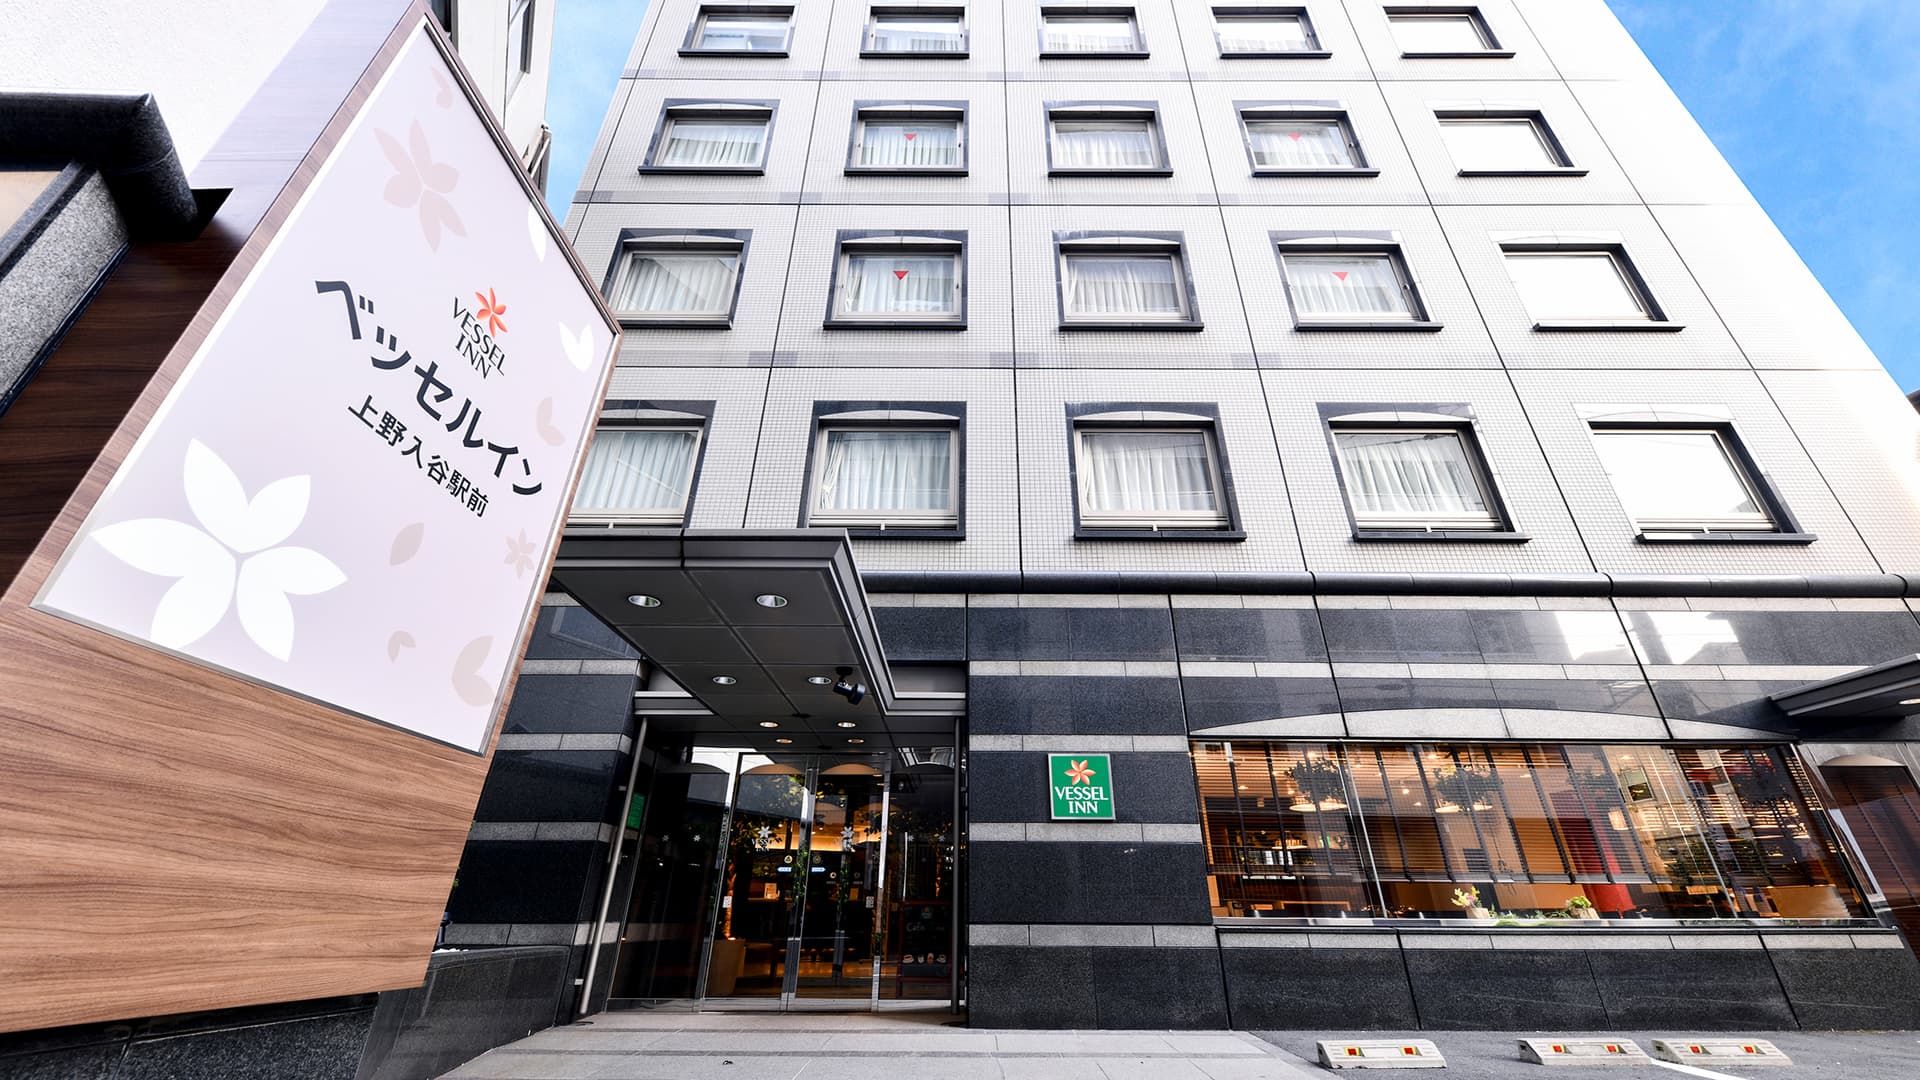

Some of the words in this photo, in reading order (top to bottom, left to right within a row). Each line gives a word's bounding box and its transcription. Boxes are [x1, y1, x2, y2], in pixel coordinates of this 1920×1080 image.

[453, 296, 505, 377] VESSEL
[455, 333, 492, 380] INN
[315, 280, 543, 496] ベッセルイン
[347, 394, 489, 518] 上野入谷駅前
[1054, 786, 1109, 801] VESSEL
[1068, 801, 1098, 814] INN
